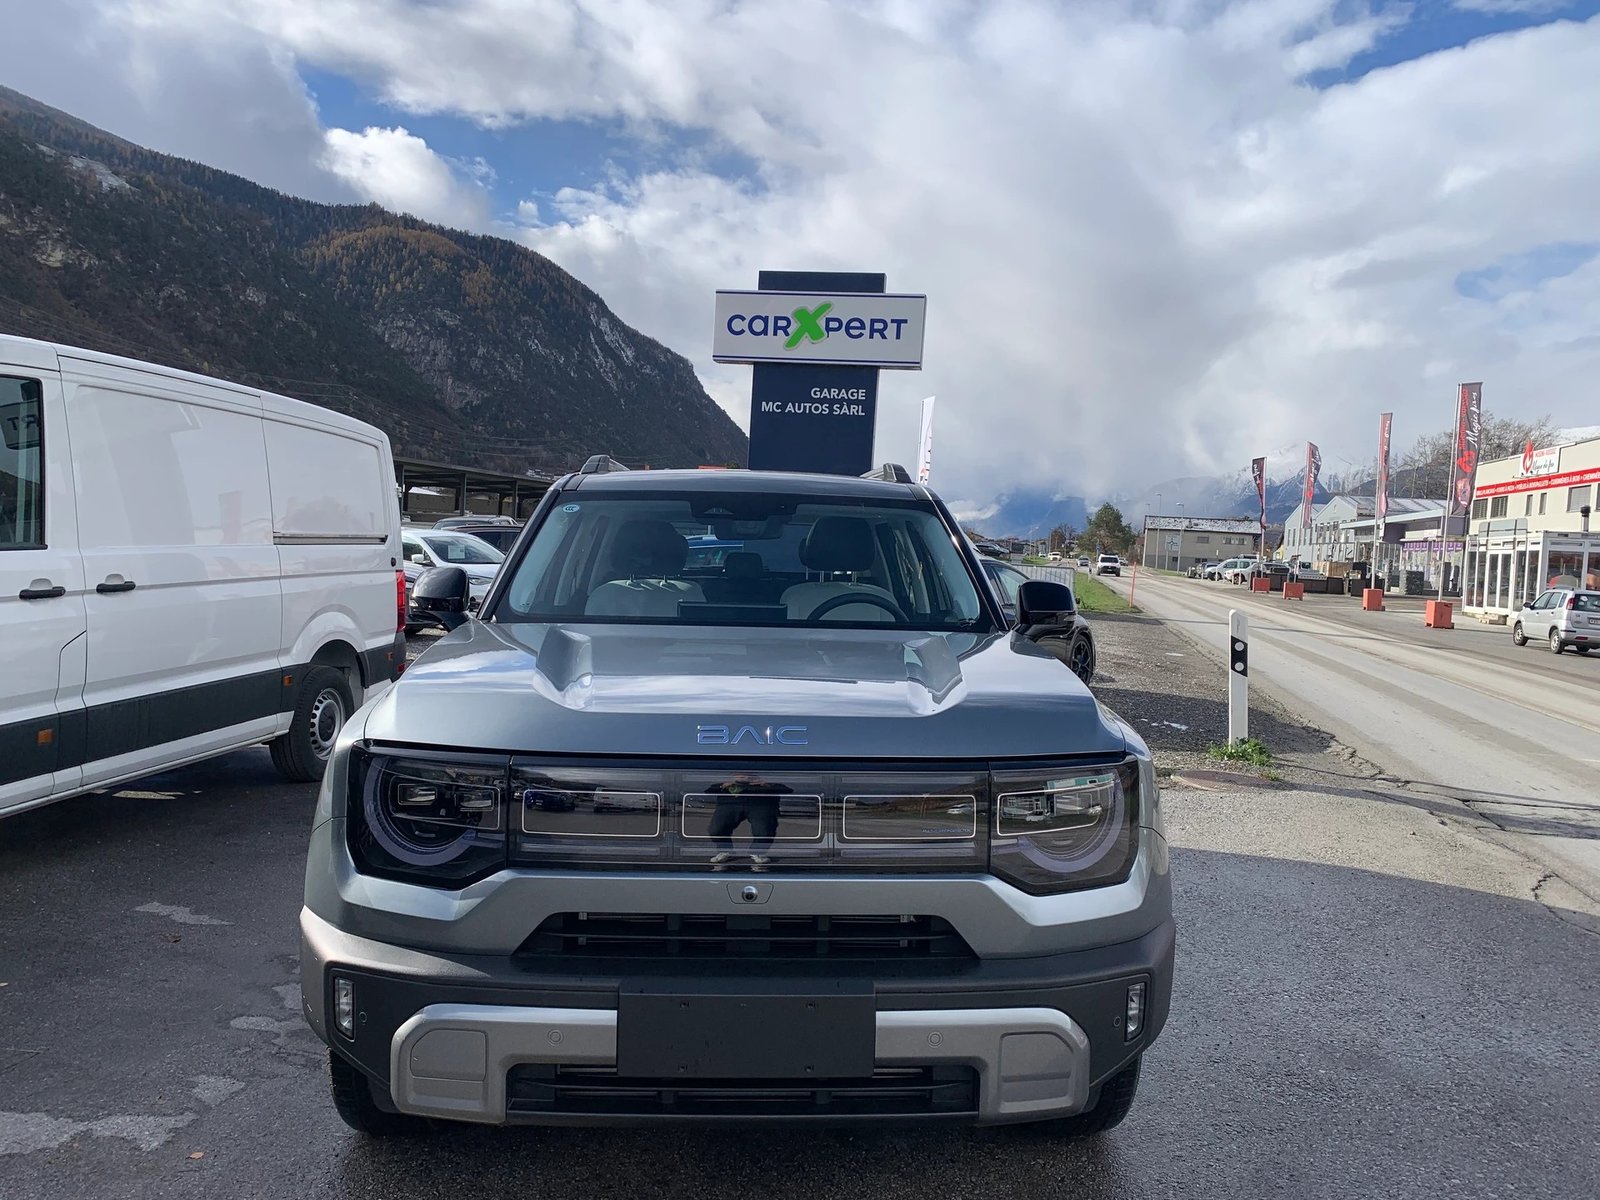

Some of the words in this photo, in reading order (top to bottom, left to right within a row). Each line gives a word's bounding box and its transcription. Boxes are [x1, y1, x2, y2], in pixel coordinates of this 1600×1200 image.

[811, 387, 866, 400] GARAGE
[761, 401, 782, 413] MC
[785, 402, 829, 415] AUTOS
[833, 403, 866, 416] SÀRL
[697, 725, 809, 745] BAIC
